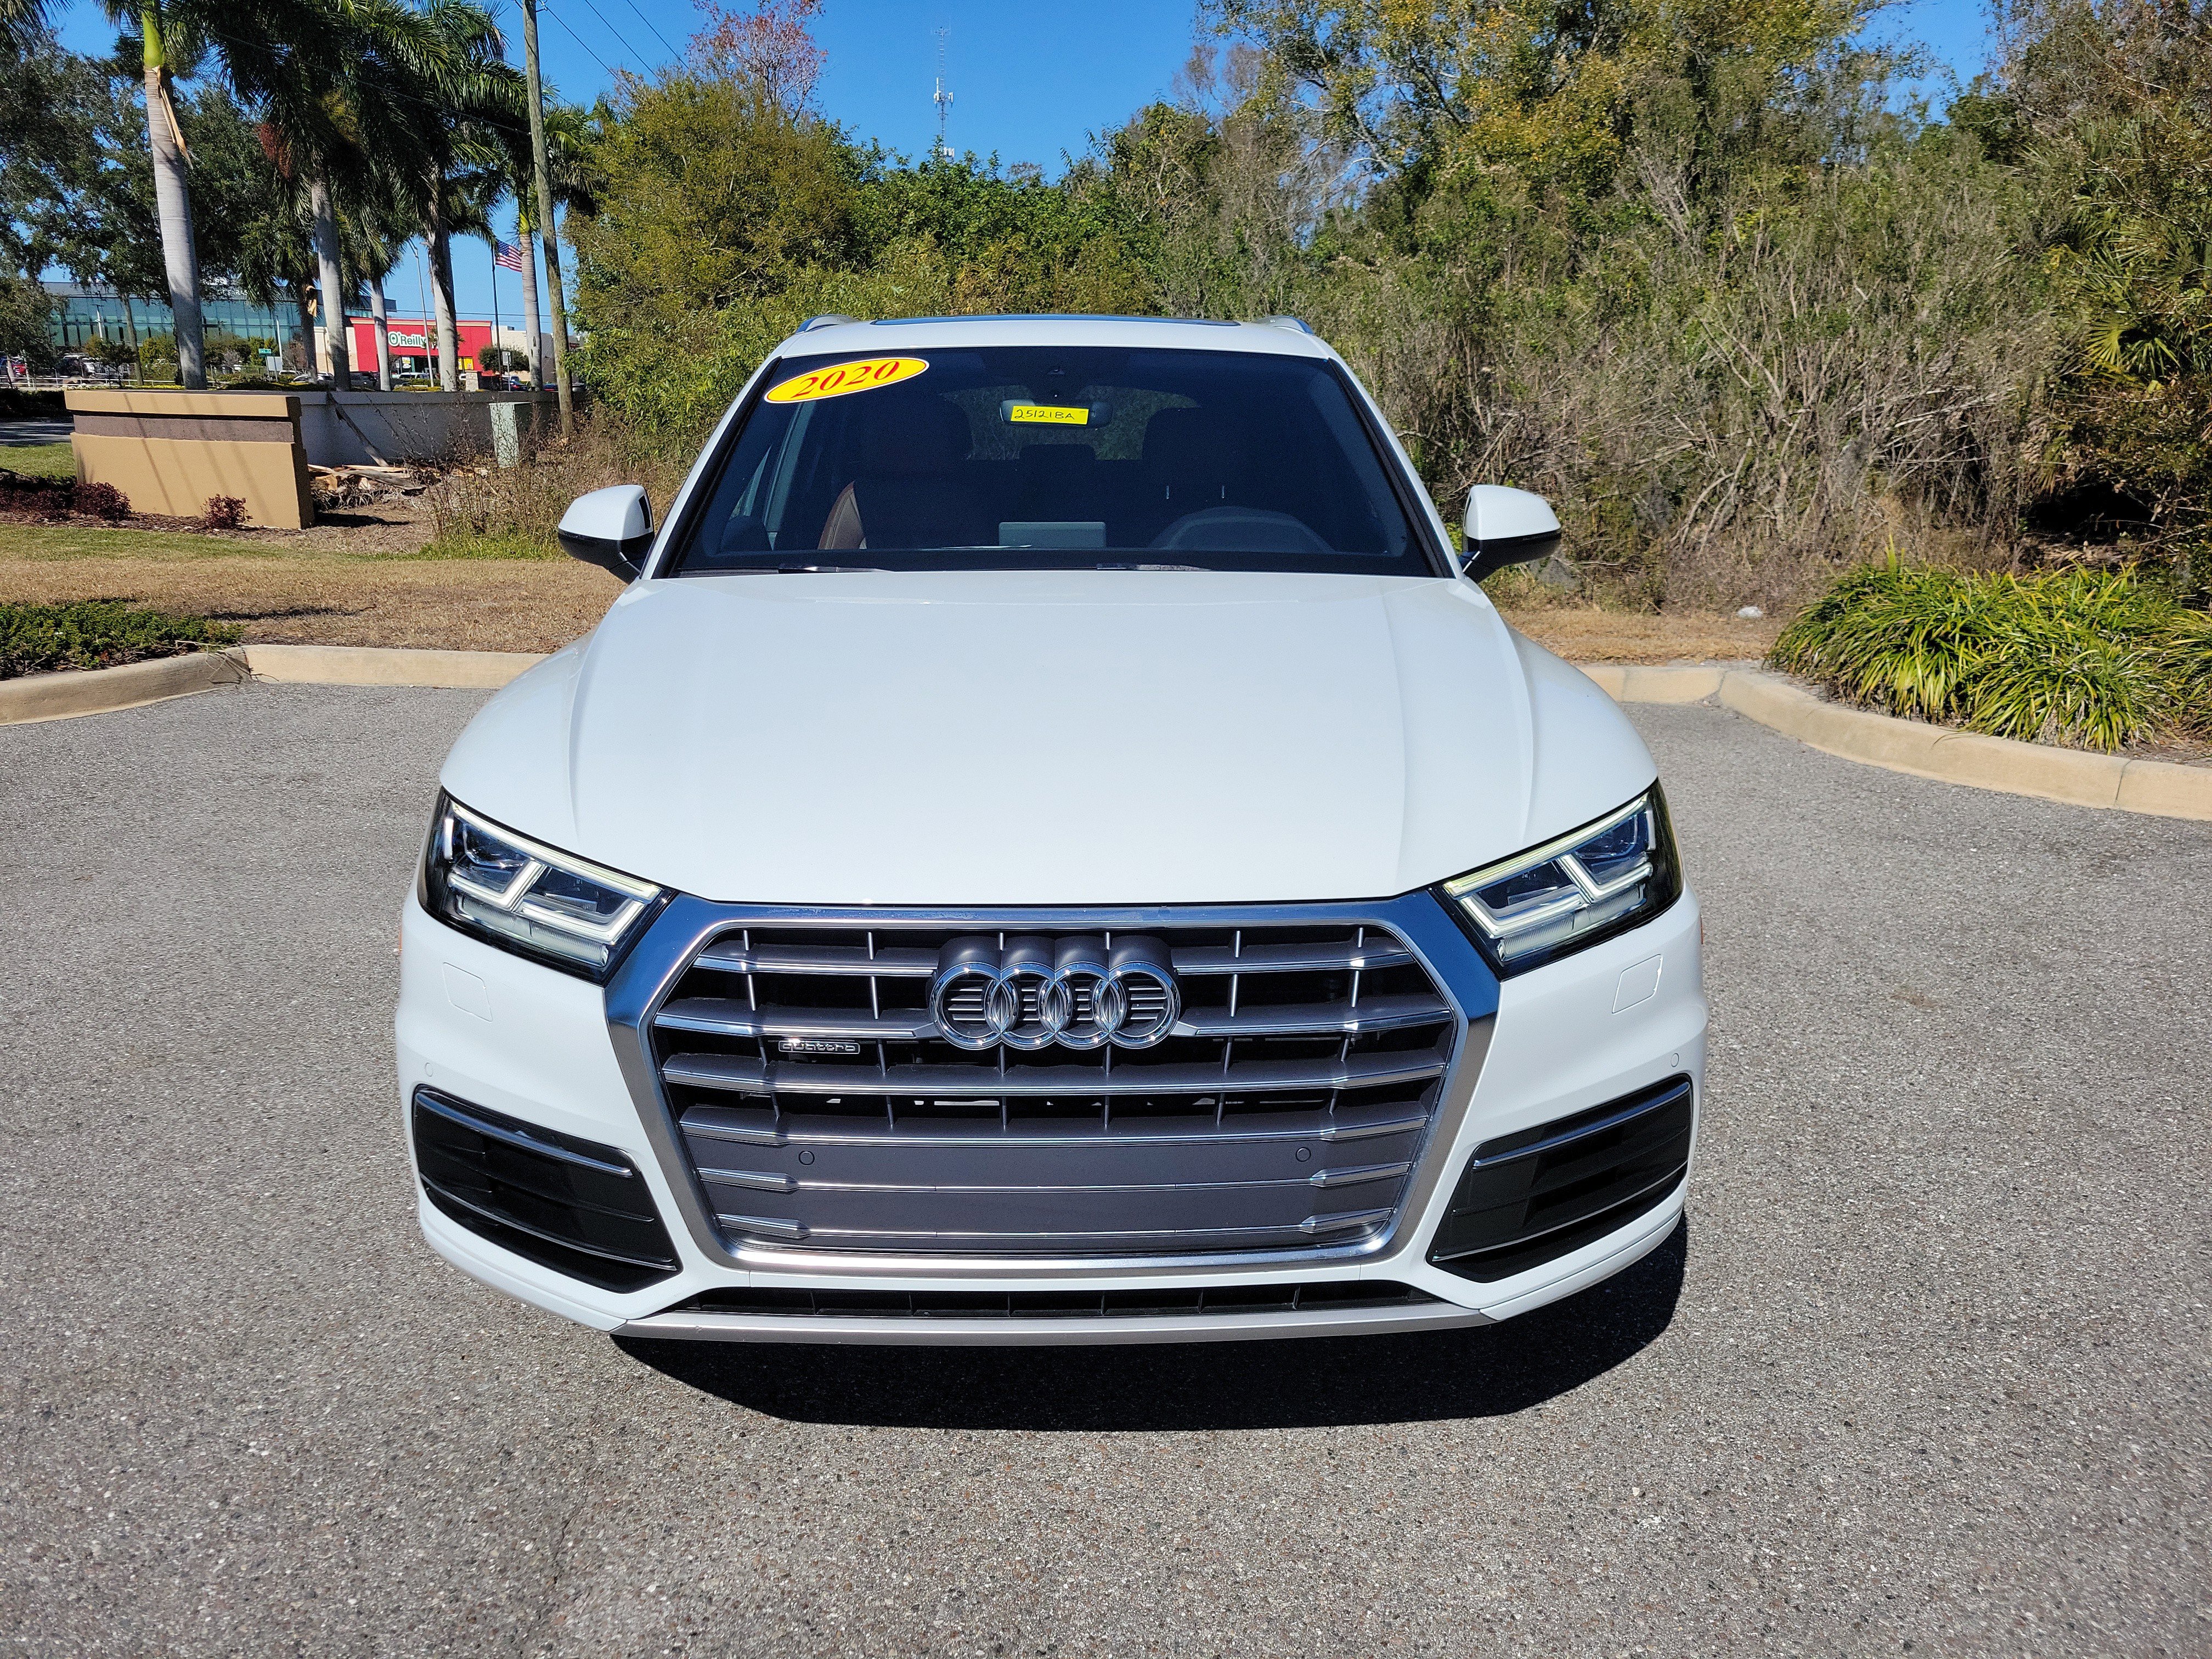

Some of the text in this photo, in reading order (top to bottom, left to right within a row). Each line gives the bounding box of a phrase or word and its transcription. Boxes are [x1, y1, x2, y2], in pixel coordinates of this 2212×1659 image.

[388, 332, 427, 347] O'Reilly
[790, 361, 900, 399] 2020
[782, 1043, 856, 1052] quattro
